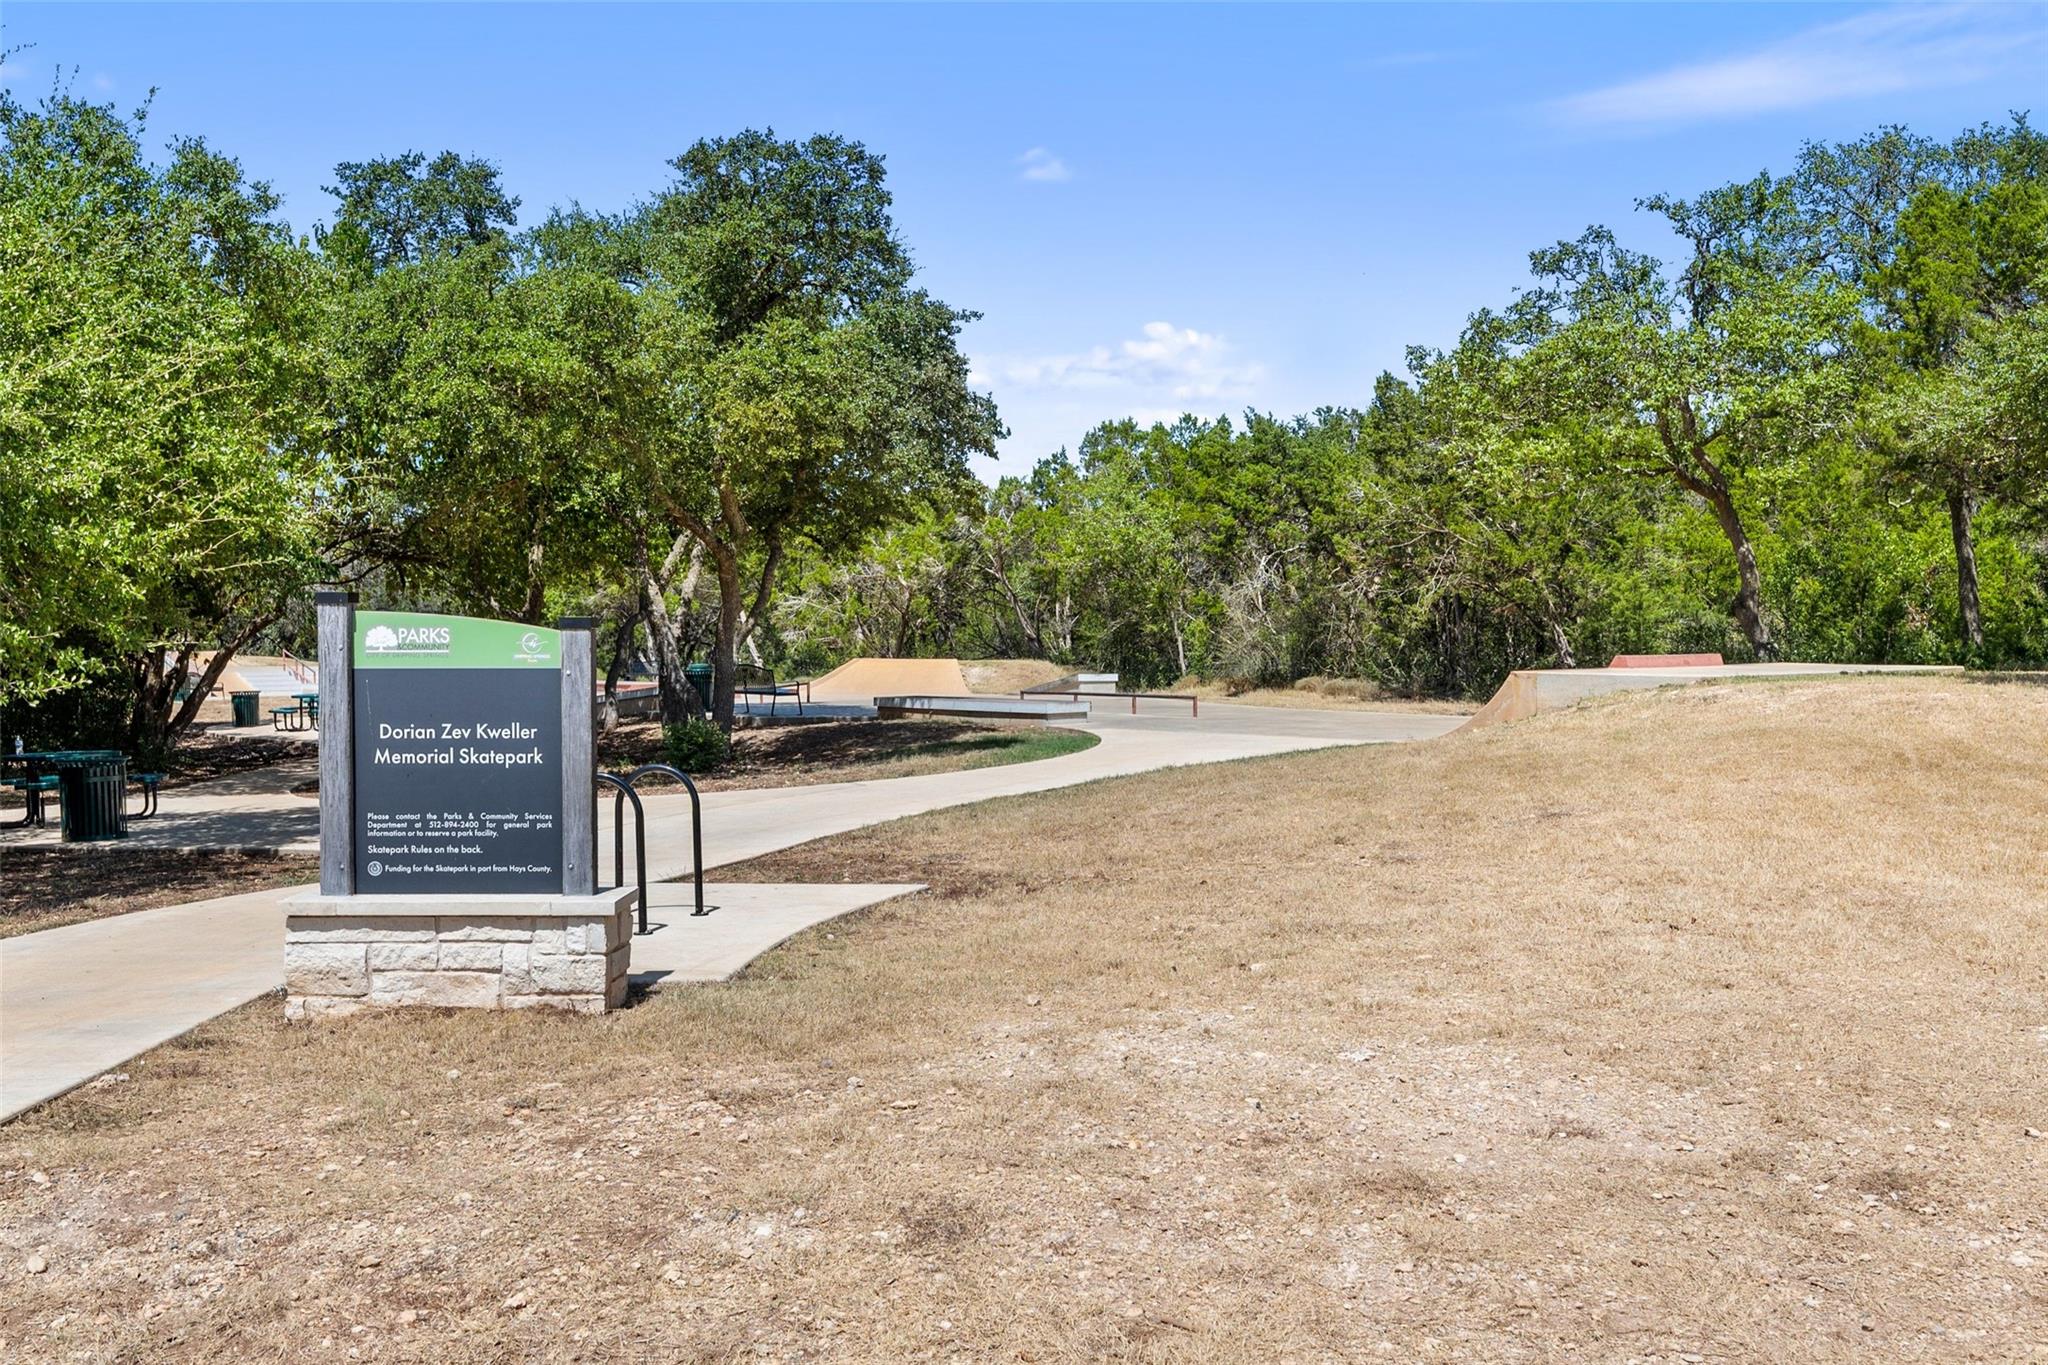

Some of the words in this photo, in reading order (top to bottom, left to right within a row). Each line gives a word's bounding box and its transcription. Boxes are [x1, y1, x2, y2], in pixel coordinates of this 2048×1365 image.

[398, 627, 450, 644] PARKS
[379, 723, 436, 739] Dorian
[441, 723, 471, 739] Zev
[476, 722, 538, 739] Kweller
[374, 747, 454, 764] Memorial
[459, 747, 543, 768] Skatepark
[367, 812, 390, 820] Please
[395, 812, 421, 820] contact
[426, 812, 438, 820] the
[443, 812, 462, 820] Parks
[468, 812, 475, 820] &
[480, 812, 518, 822] Community
[524, 812, 553, 820] Services
[367, 821, 408, 830] Department
[503, 821, 530, 830] general
[536, 821, 553, 830] park
[367, 829, 407, 837] information
[457, 829, 473, 838] park
[474, 829, 499, 838] facility.
[367, 845, 410, 855] Skatepark
[411, 845, 432, 854] Rules
[446, 845, 459, 854] the
[461, 844, 484, 854] back.
[385, 864, 412, 874] Funding
[412, 864, 423, 872] for
[423, 864, 434, 872] the
[435, 864, 469, 874] Skatepark
[477, 865, 492, 874] part
[492, 864, 508, 872] from
[509, 864, 526, 874] Hays
[527, 864, 553, 874] County.
